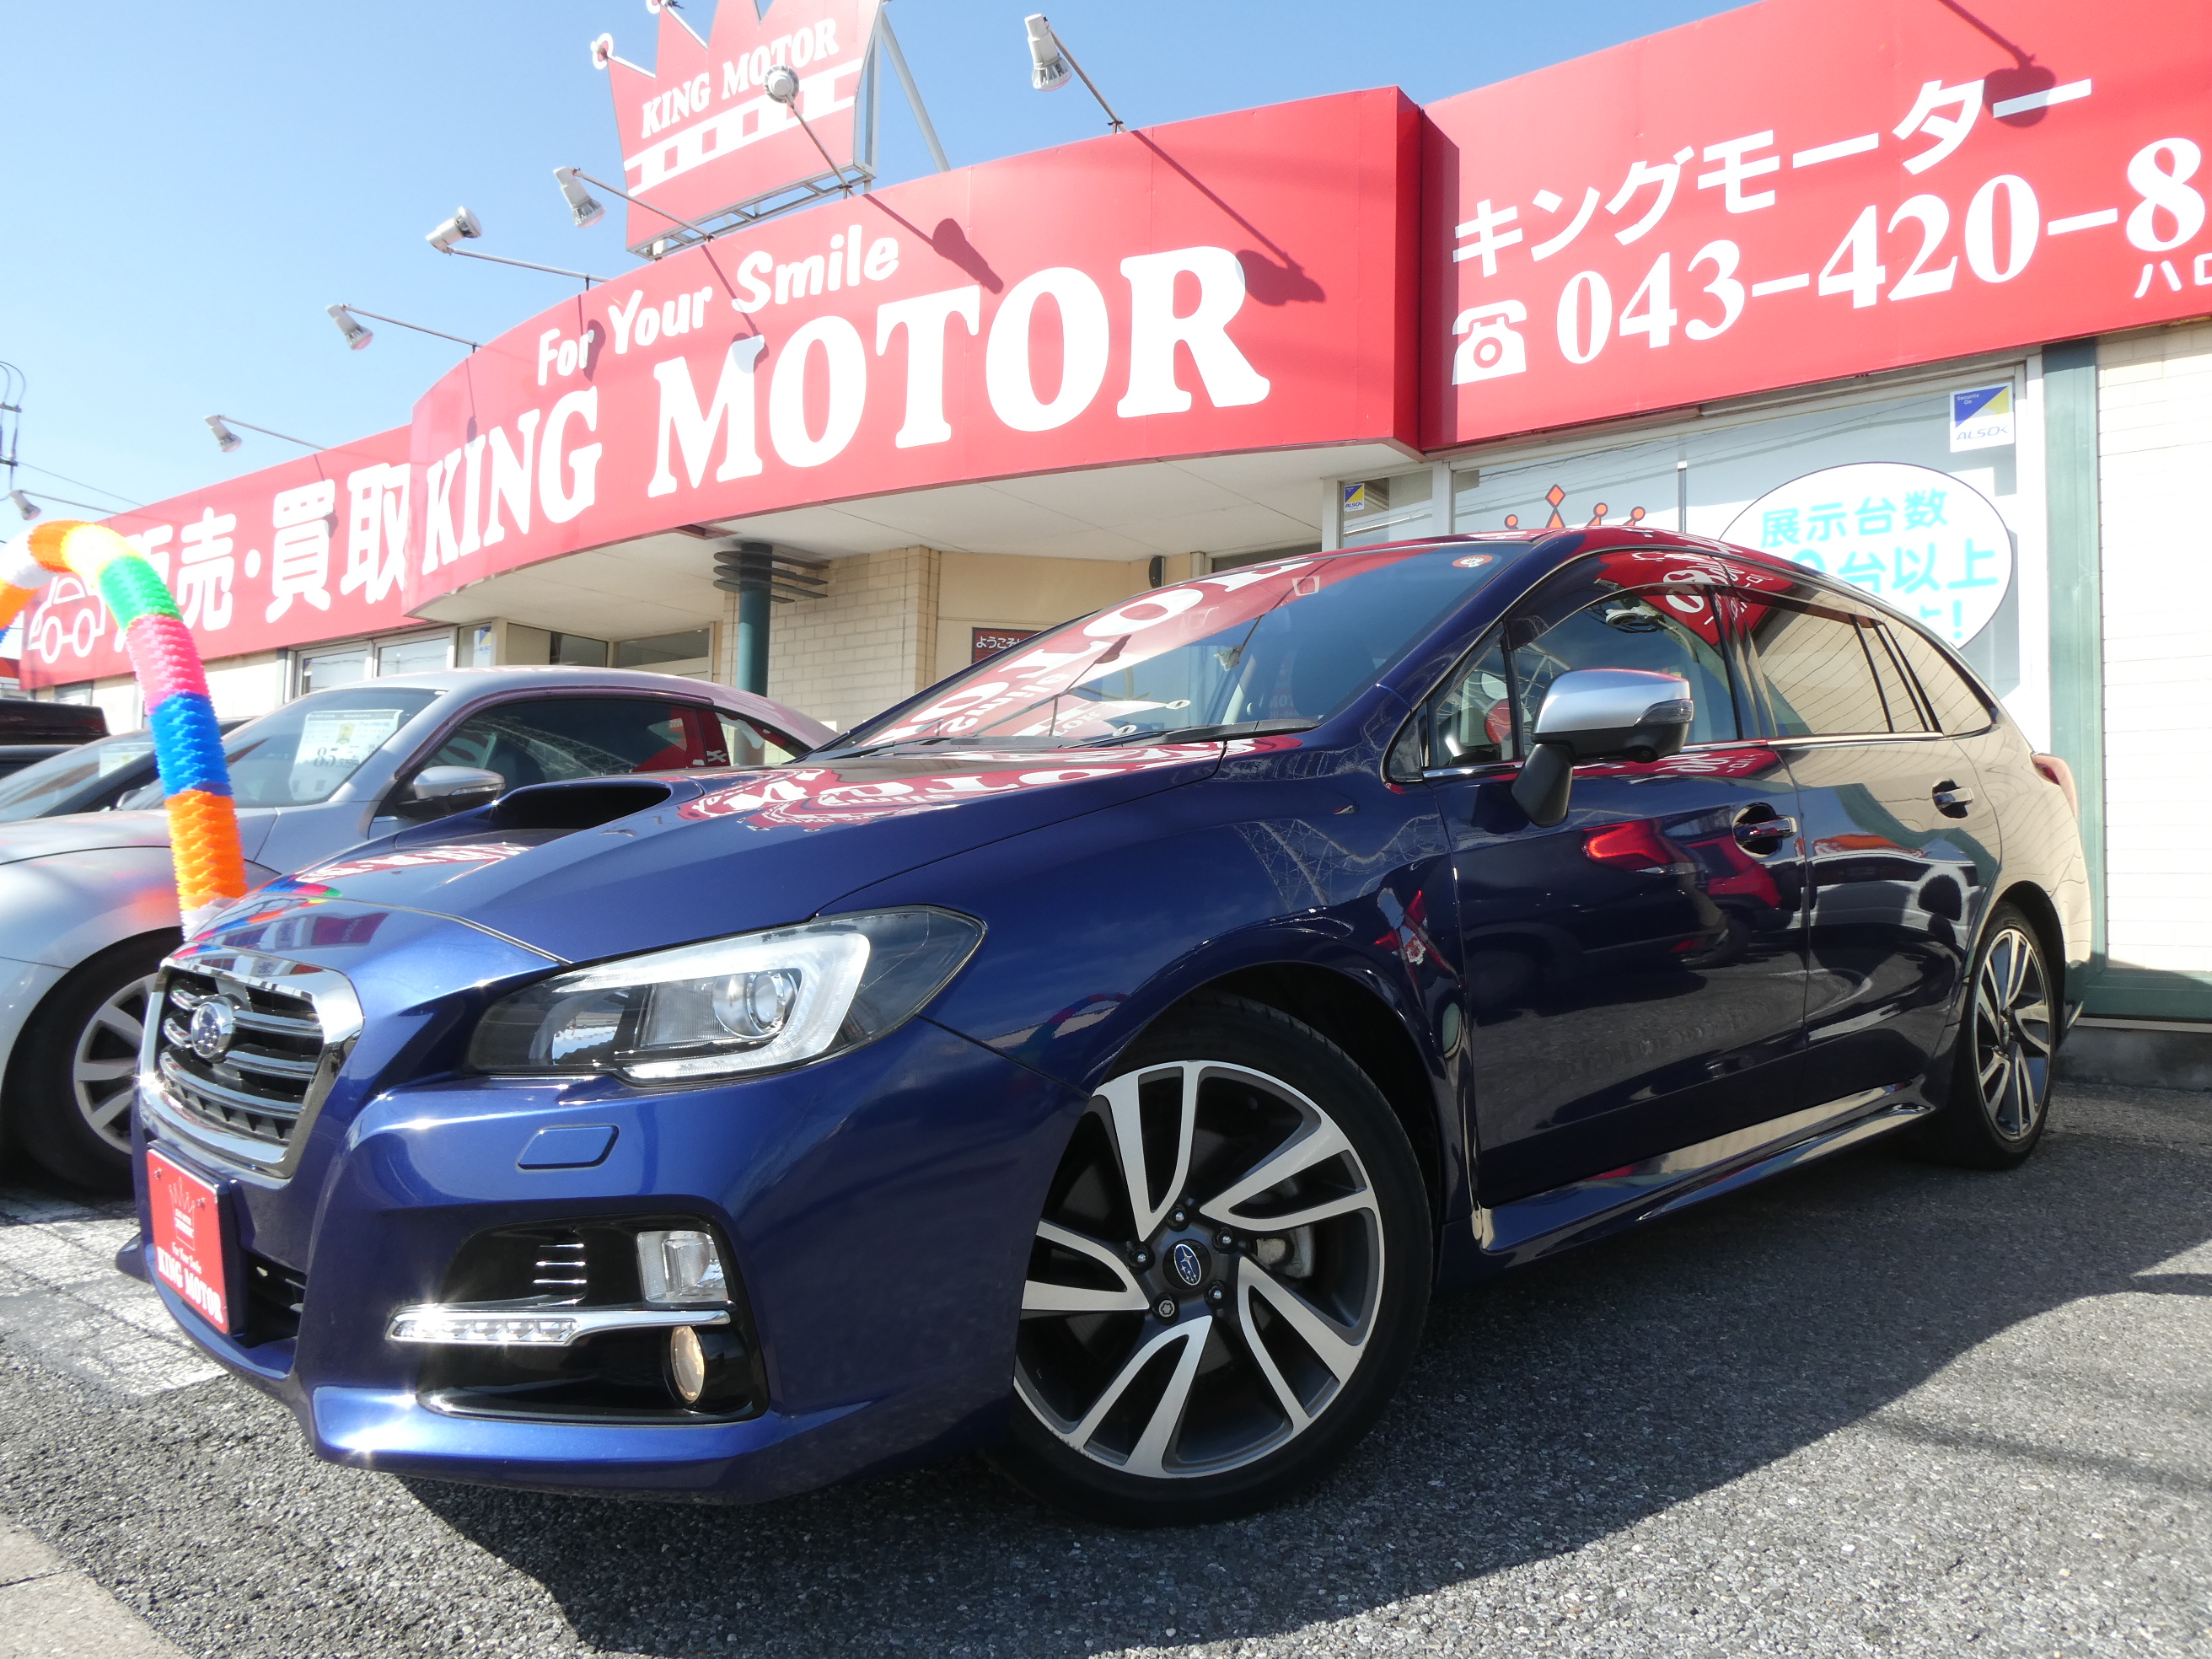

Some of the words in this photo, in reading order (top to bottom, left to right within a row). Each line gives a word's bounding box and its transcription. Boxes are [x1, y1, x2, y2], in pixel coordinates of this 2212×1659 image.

[642, 72, 711, 139] KING
[721, 18, 840, 100] MOTOR
[1452, 78, 2092, 278] キングモーター
[537, 328, 595, 387] For
[608, 289, 714, 355] Your
[731, 224, 899, 314] Smile
[421, 385, 603, 576] KING
[647, 246, 1270, 499] MOTOR
[1956, 425, 2009, 441] ALSOK
[1761, 488, 1949, 549] 展示台数
[976, 636, 1022, 649] ようこそ
[157, 1246, 184, 1289] KING
[184, 1267, 224, 1324] MOTOR
